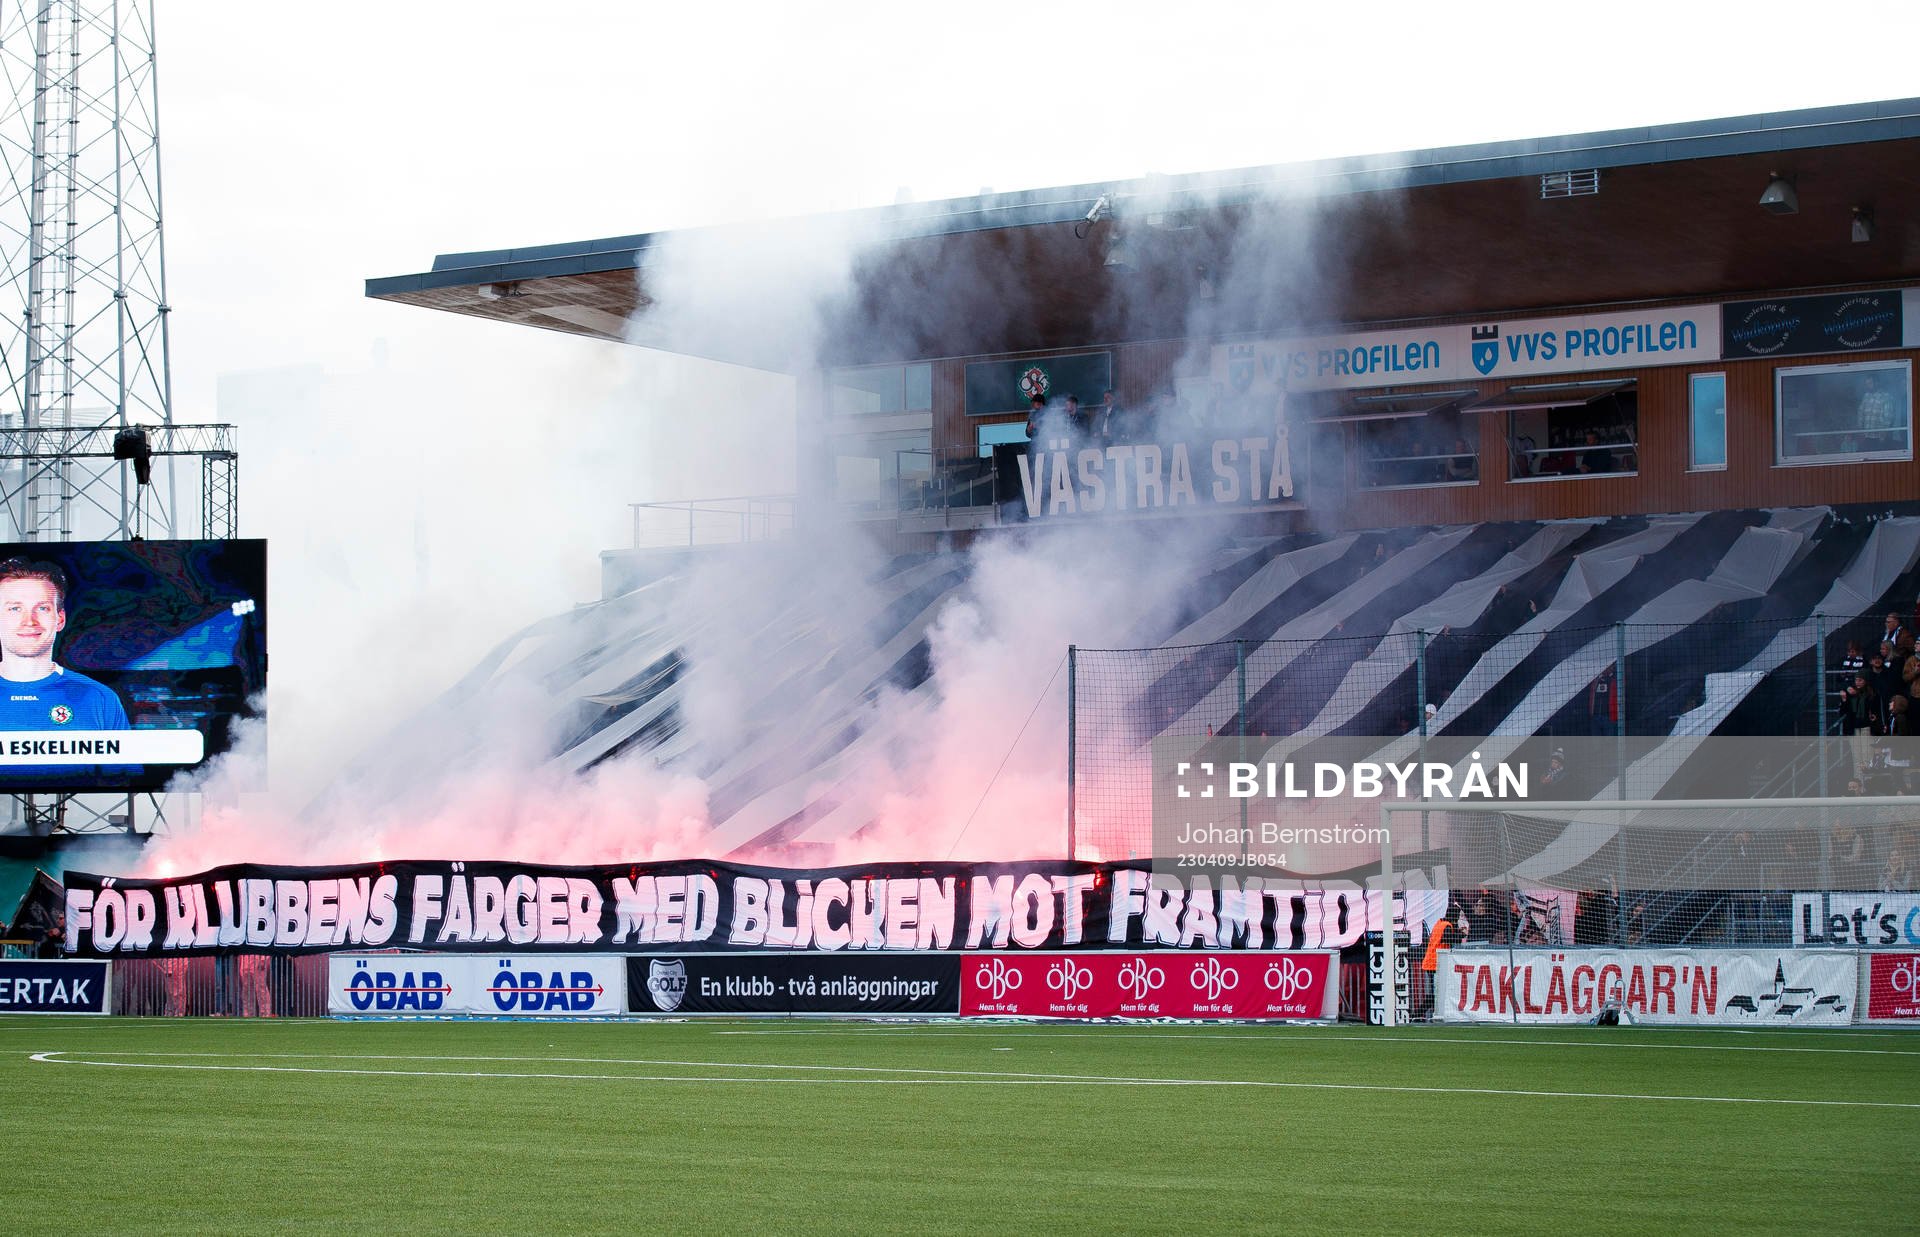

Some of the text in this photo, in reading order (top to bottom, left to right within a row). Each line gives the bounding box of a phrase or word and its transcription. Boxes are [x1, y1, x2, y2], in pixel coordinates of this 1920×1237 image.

[1506, 331, 1557, 362] VVS
[1017, 424, 1294, 518] VÄSTRA STÅ
[10, 740, 120, 755] ESKELINEN
[64, 877, 155, 952] FÖR
[162, 874, 398, 949] KLUBBENS
[407, 861, 604, 944] FÄRGER
[611, 874, 719, 944] MED
[965, 873, 1096, 949] MOT
[1803, 903, 1898, 945] Let's
[0, 978, 91, 1004] ERTAK
[350, 960, 443, 1011] ÖBAB
[493, 960, 596, 1011] ÖBAB
[649, 977, 686, 993] GOLF
[701, 976, 721, 996] En
[726, 976, 775, 996] klubb
[788, 975, 816, 996] två
[820, 975, 939, 1001] anläggningar
[1369, 944, 1384, 1024] SELECT
[1395, 945, 1410, 1024] SELECT
[1454, 953, 1718, 1015] TAKLÄGGAR'N
[978, 1003, 1018, 1012] Hem för dig
[1050, 1003, 1088, 1013] Hem för dig
[1138, 1003, 1147, 1011] för
[1148, 1004, 1159, 1012] dig
[1193, 1004, 1233, 1013] Hem för dig
[1267, 1004, 1306, 1013] Hem för dig
[1895, 1006, 1913, 1015] Hem
